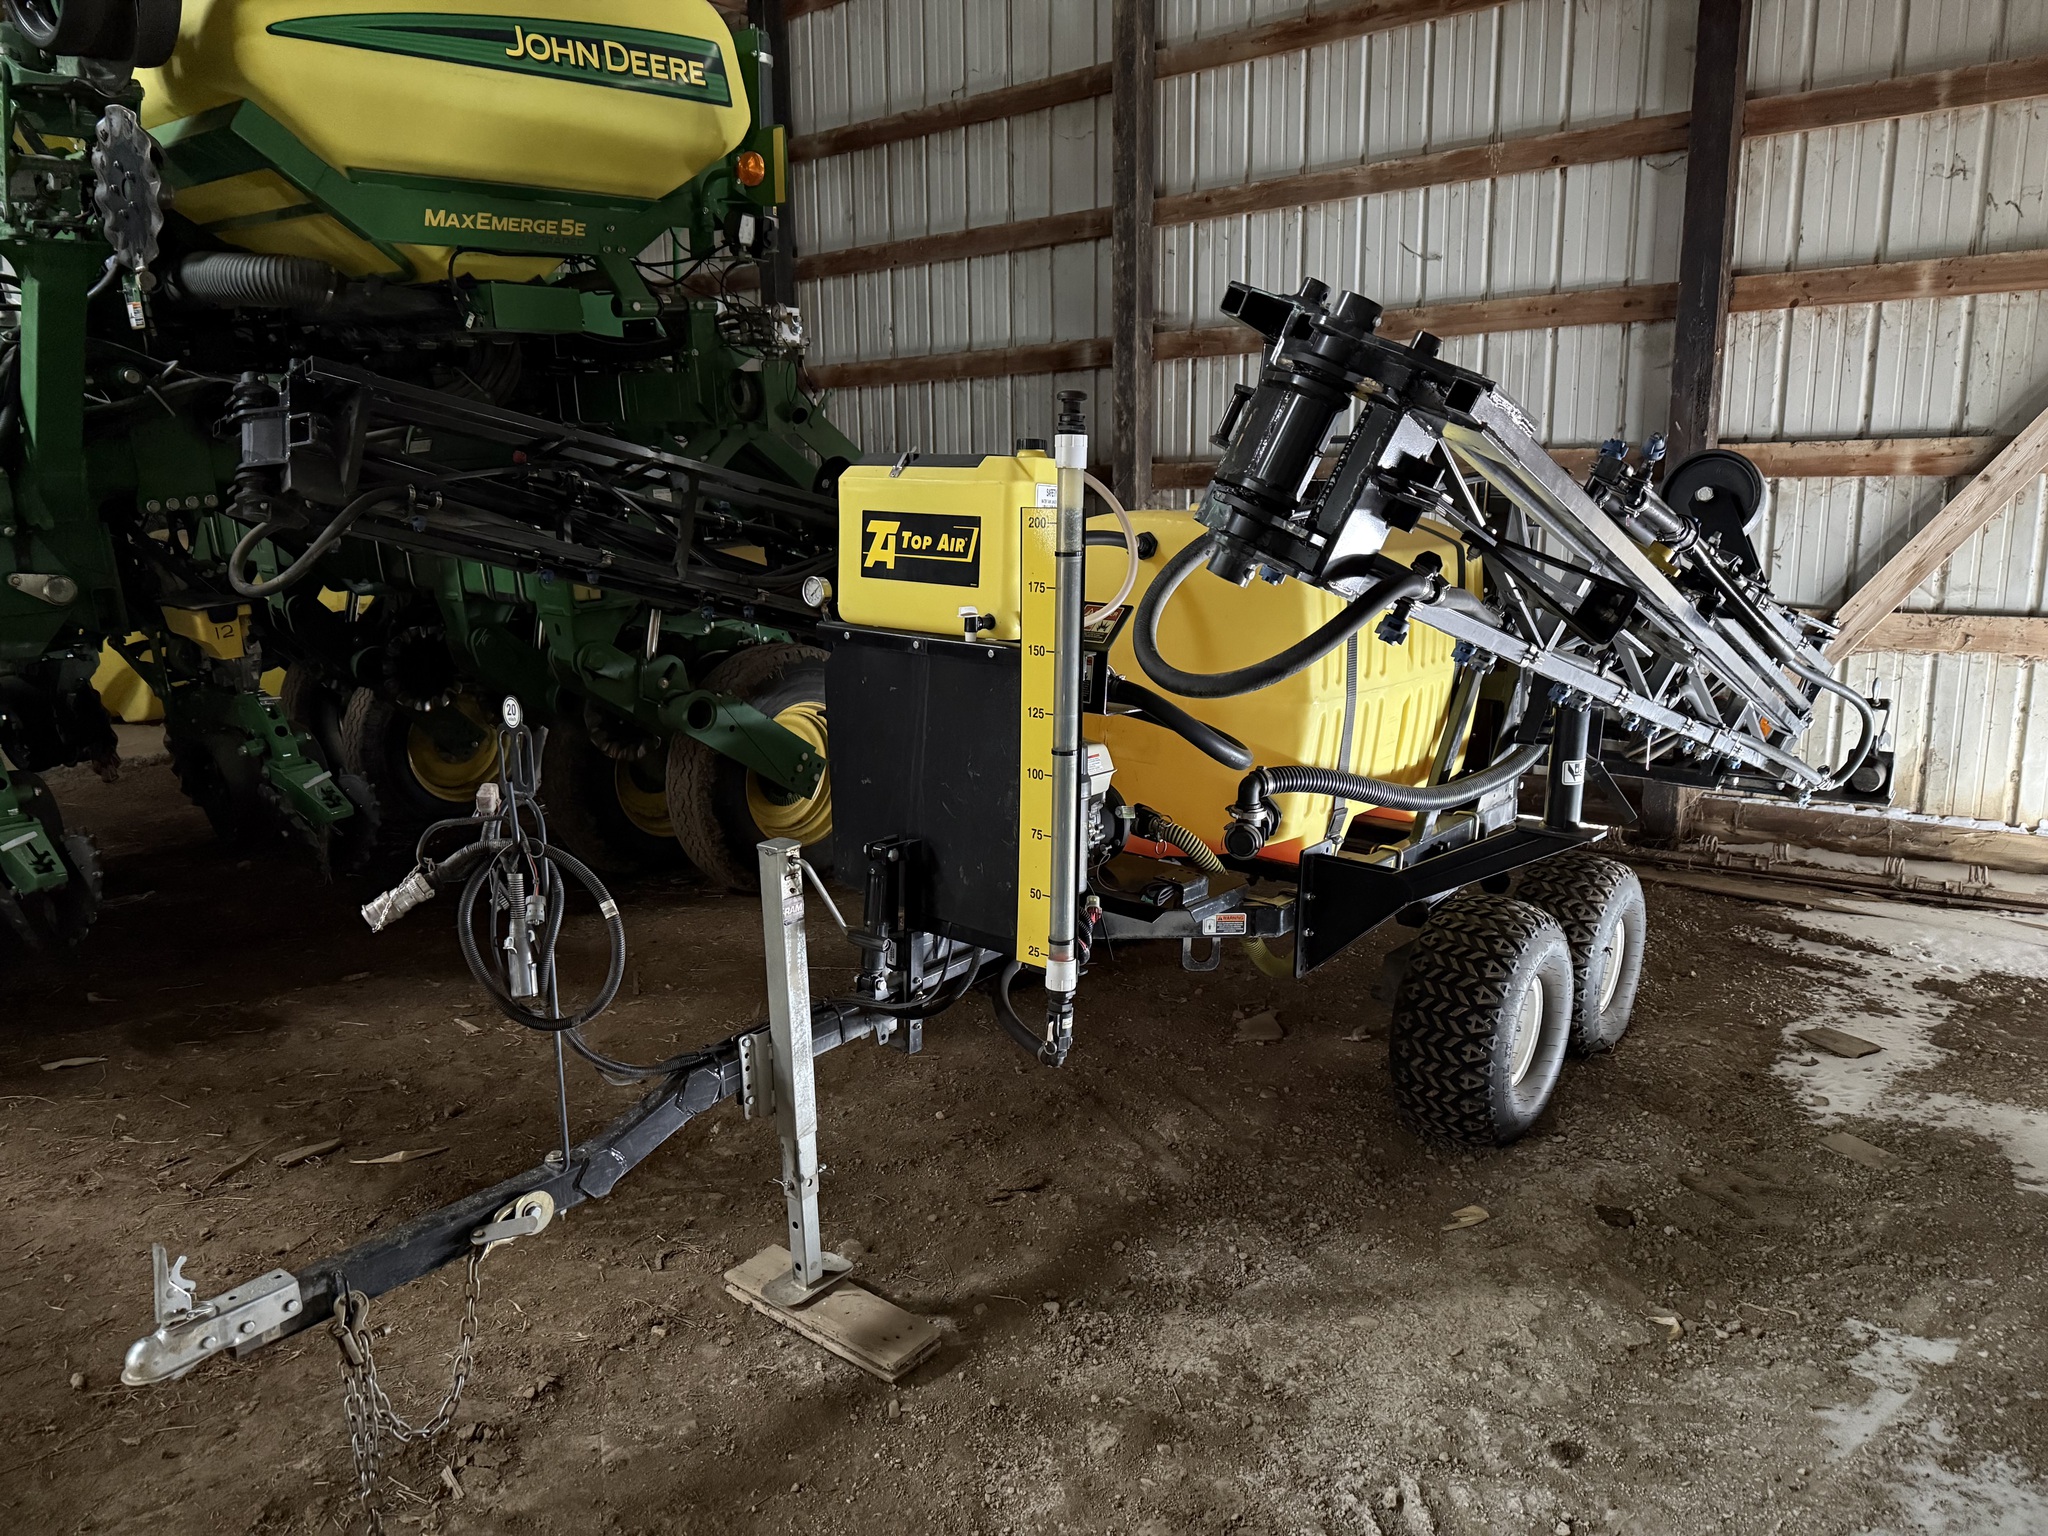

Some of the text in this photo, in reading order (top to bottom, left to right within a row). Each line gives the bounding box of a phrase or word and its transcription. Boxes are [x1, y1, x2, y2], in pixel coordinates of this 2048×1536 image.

[505, 25, 706, 86] JOHN DEERE
[560, 218, 587, 237] 5E
[1028, 516, 1046, 529] 200
[902, 531, 932, 550] TOP
[1028, 581, 1046, 593] 175
[214, 624, 235, 640] 12
[1028, 645, 1045, 657] 150
[506, 703, 517, 716] 20
[1027, 708, 1045, 719] 125
[1026, 768, 1044, 780] 100
[1031, 829, 1043, 840] 75
[1029, 888, 1042, 900] 50
[1028, 946, 1040, 957] 25
